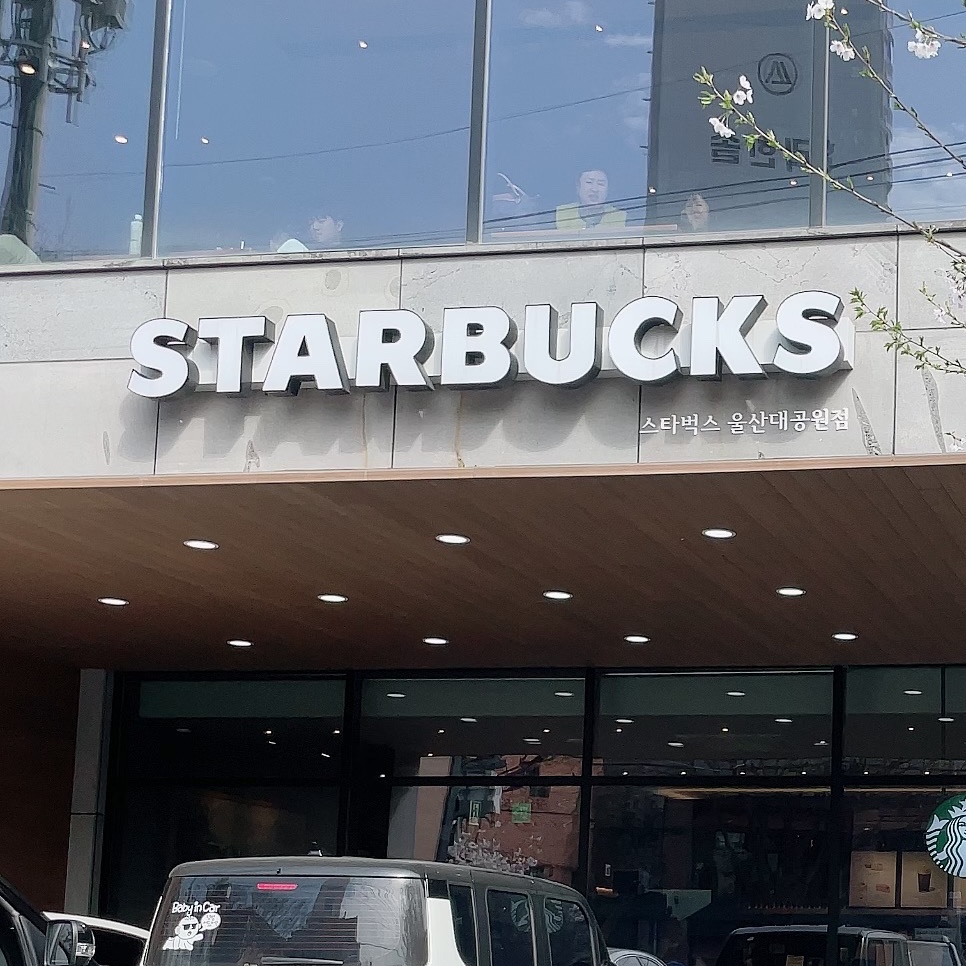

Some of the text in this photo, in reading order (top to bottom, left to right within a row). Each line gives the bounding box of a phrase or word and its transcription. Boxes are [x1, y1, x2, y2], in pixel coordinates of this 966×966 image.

[127, 290, 847, 398] STARBUCKS
[639, 407, 849, 436] 스타벅스 울산대공원점
[172, 900, 220, 916] Baby in Car
